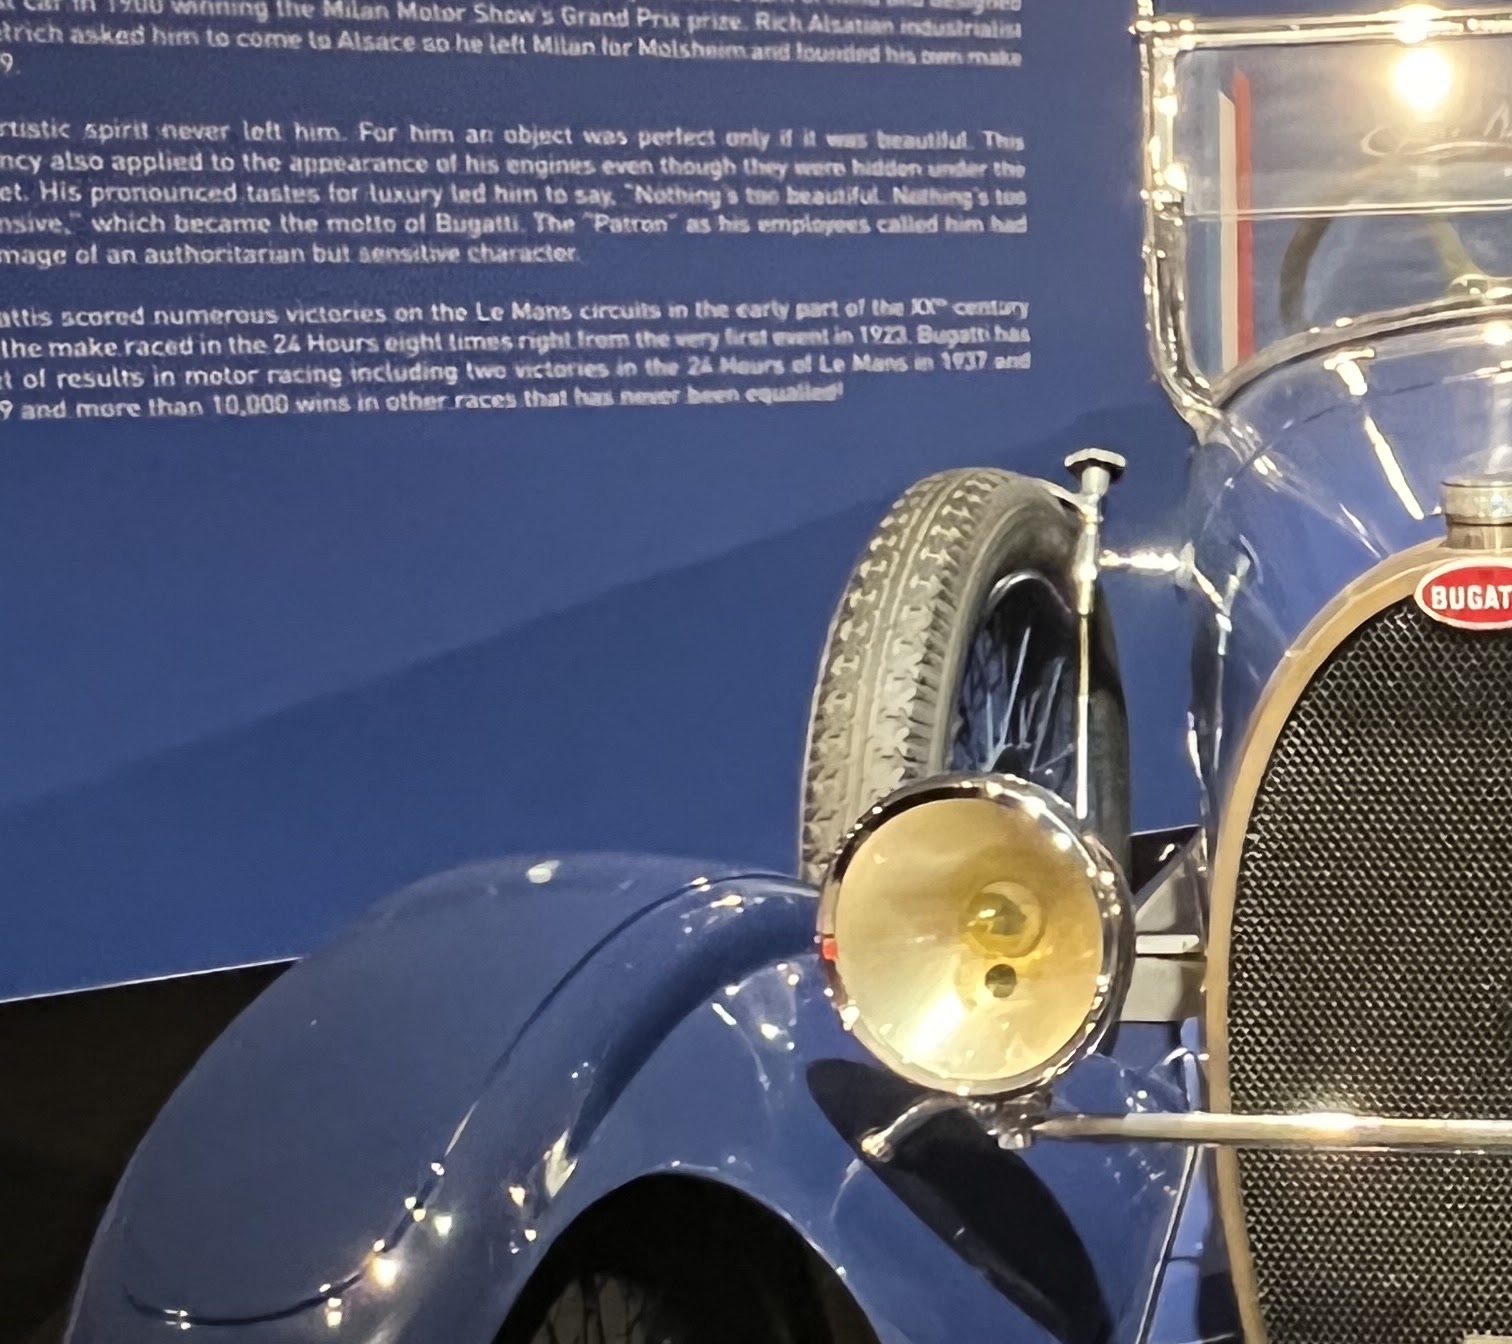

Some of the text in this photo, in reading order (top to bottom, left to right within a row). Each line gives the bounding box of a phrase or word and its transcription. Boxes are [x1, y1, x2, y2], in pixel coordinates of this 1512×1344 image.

[169, 0, 269, 23] winning
[321, 0, 390, 21] Milan
[396, 1, 467, 23] Motor
[560, 6, 630, 28] Grand
[69, 23, 748, 61] asked him to come to Alsace so he left Milan for Molsheim
[84, 122, 149, 143] spirit
[160, 124, 231, 140] never
[242, 120, 281, 141] left
[357, 121, 398, 143] For
[409, 124, 455, 144] him
[465, 128, 494, 144] an
[503, 124, 572, 148] object
[582, 130, 629, 146] was
[637, 127, 716, 151] perfect
[49, 151, 104, 171] also
[111, 151, 204, 176] applied
[210, 153, 236, 172] to
[241, 152, 282, 173] the
[289, 156, 429, 179] appearance
[435, 153, 458, 174] of
[464, 153, 500, 174] his
[505, 159, 596, 179] engines
[600, 159, 654, 176] even
[659, 156, 737, 181] though
[39, 180, 83, 202] His
[90, 183, 238, 207] pronounced
[246, 185, 321, 204] tastes
[327, 183, 359, 204] for
[368, 184, 444, 209] luxury
[449, 181, 487, 205] led
[493, 184, 539, 204] him
[544, 185, 569, 205] to
[90, 213, 166, 233] which
[173, 214, 272, 233] became
[279, 213, 319, 233] the
[326, 215, 397, 233] motto
[404, 213, 426, 233] of
[532, 211, 576, 233] The
[685, 217, 712, 234] as
[75, 243, 98, 265] of
[106, 249, 137, 265] an
[144, 244, 306, 264] authoritarian
[311, 243, 350, 264] but
[358, 245, 461, 264] sensitive
[61, 307, 145, 327] scored
[153, 308, 280, 326] numerous
[285, 307, 387, 325] victories
[393, 306, 424, 323] on
[430, 303, 468, 323] the
[475, 302, 505, 322] Le
[511, 300, 573, 322] Mans
[579, 303, 662, 321] circuits
[667, 301, 689, 320] in
[0, 338, 43, 359] the
[47, 337, 118, 358] make
[123, 338, 194, 357] raced
[199, 336, 222, 355] in
[227, 334, 268, 355] the
[273, 333, 301, 354] 24
[306, 333, 380, 354] Hours
[384, 333, 443, 357] eight
[448, 333, 514, 351] times
[517, 331, 572, 355] right
[576, 329, 631, 350] from
[634, 330, 671, 349] the
[22, 368, 46, 388] of
[56, 367, 145, 387] results
[152, 367, 176, 386] in
[184, 367, 260, 386] motor
[266, 368, 343, 389] racing
[349, 362, 459, 388] including
[465, 362, 507, 381] two
[514, 361, 611, 381] victories
[615, 358, 638, 378] in
[644, 357, 680, 378] the
[20, 400, 67, 420] and
[75, 402, 141, 419] more
[148, 396, 204, 417] than
[294, 397, 352, 414] wins
[357, 392, 380, 413] in
[385, 390, 448, 412] other
[454, 392, 518, 411] races
